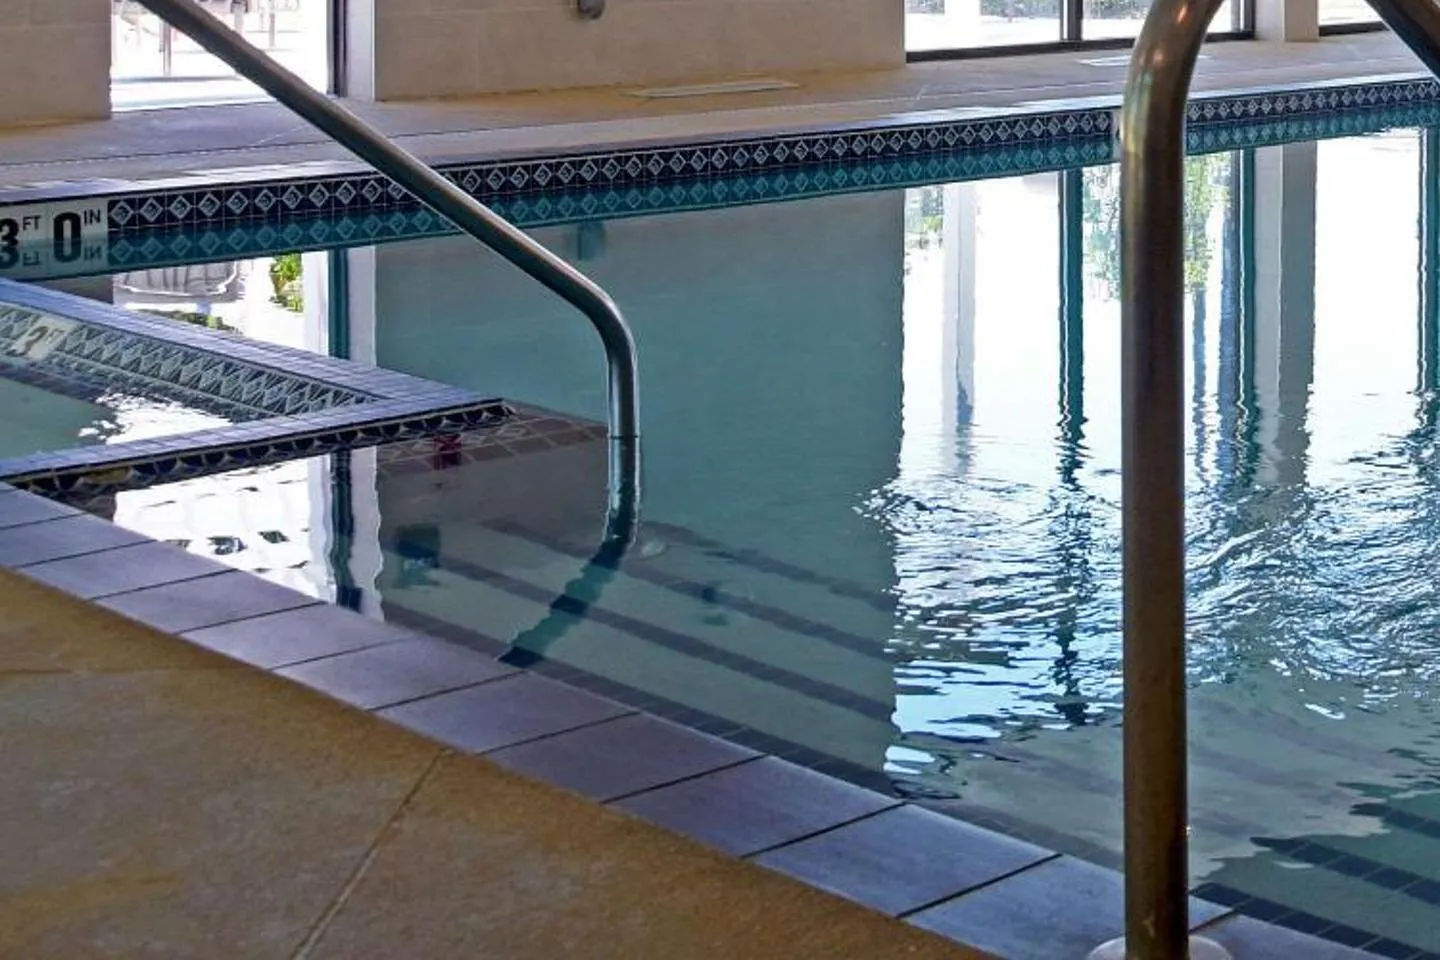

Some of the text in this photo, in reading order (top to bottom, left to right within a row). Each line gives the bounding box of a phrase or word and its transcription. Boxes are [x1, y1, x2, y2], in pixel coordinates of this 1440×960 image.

[0, 208, 101, 247] 3 FT 0 IN
